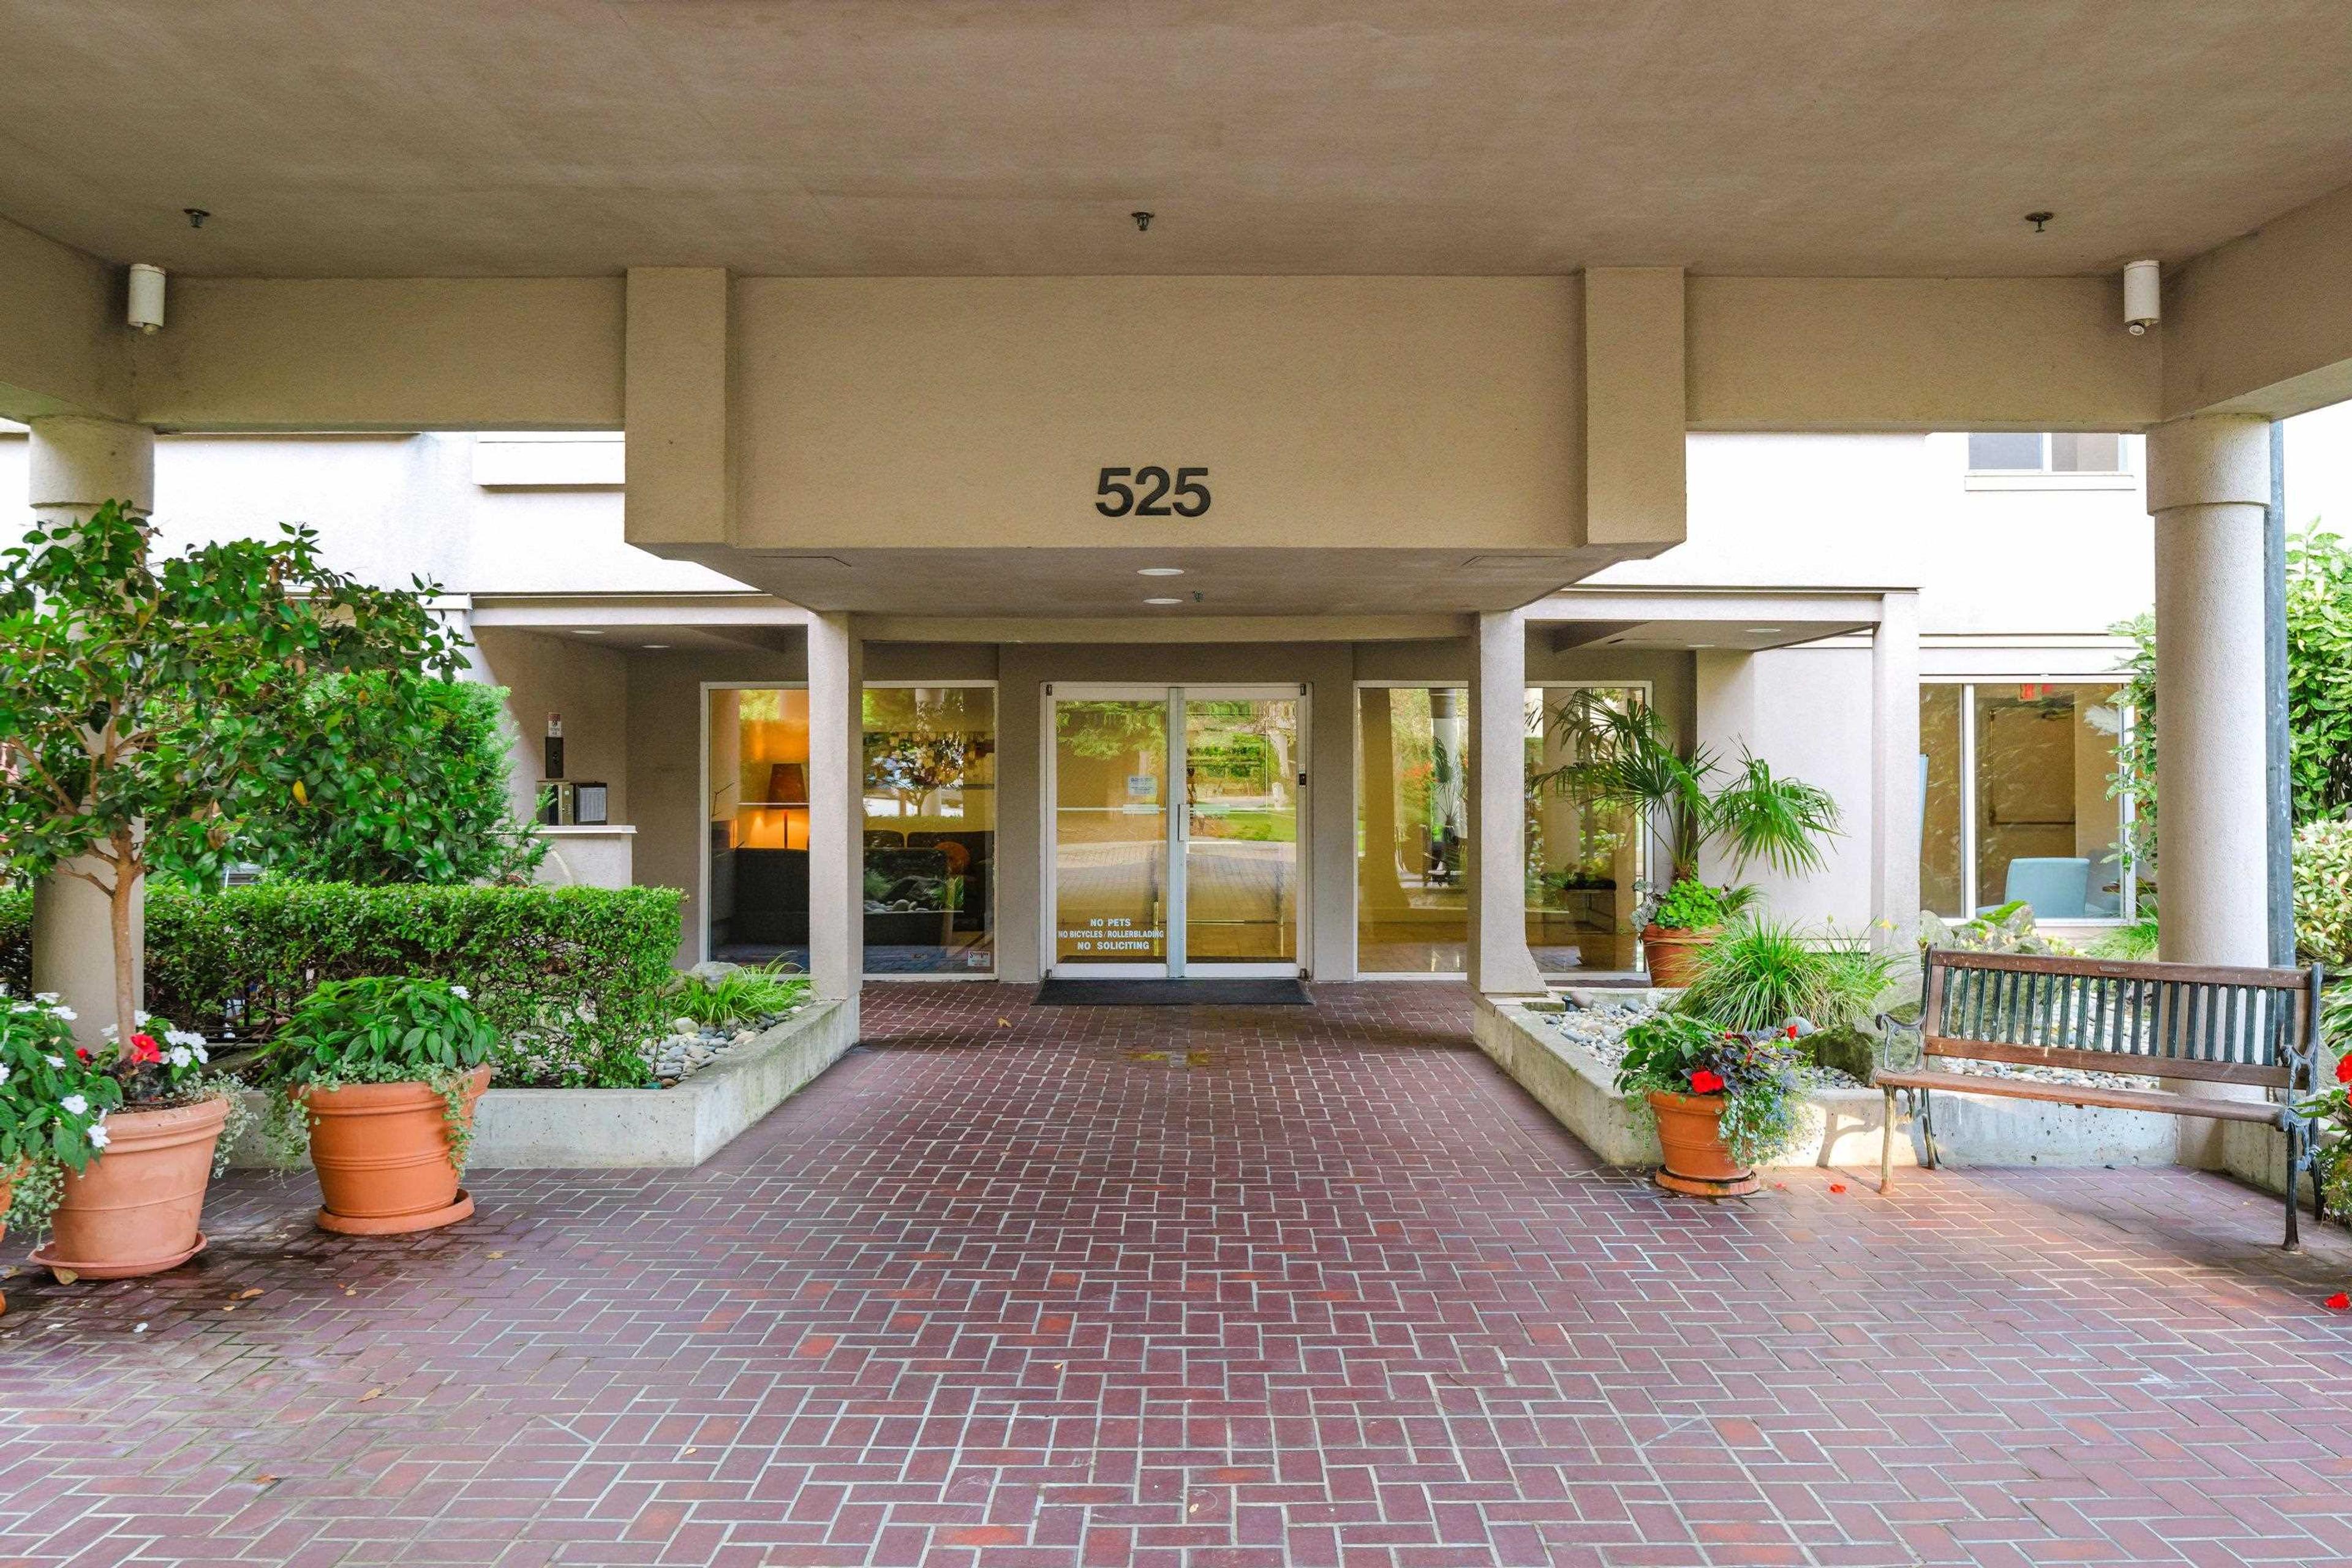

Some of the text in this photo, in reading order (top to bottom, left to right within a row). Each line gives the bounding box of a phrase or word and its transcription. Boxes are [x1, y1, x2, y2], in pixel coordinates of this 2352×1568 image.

[1095, 466, 1211, 517] 525
[1090, 918, 1131, 927] NO PETS
[1077, 941, 1150, 950] NO SOLICITING
